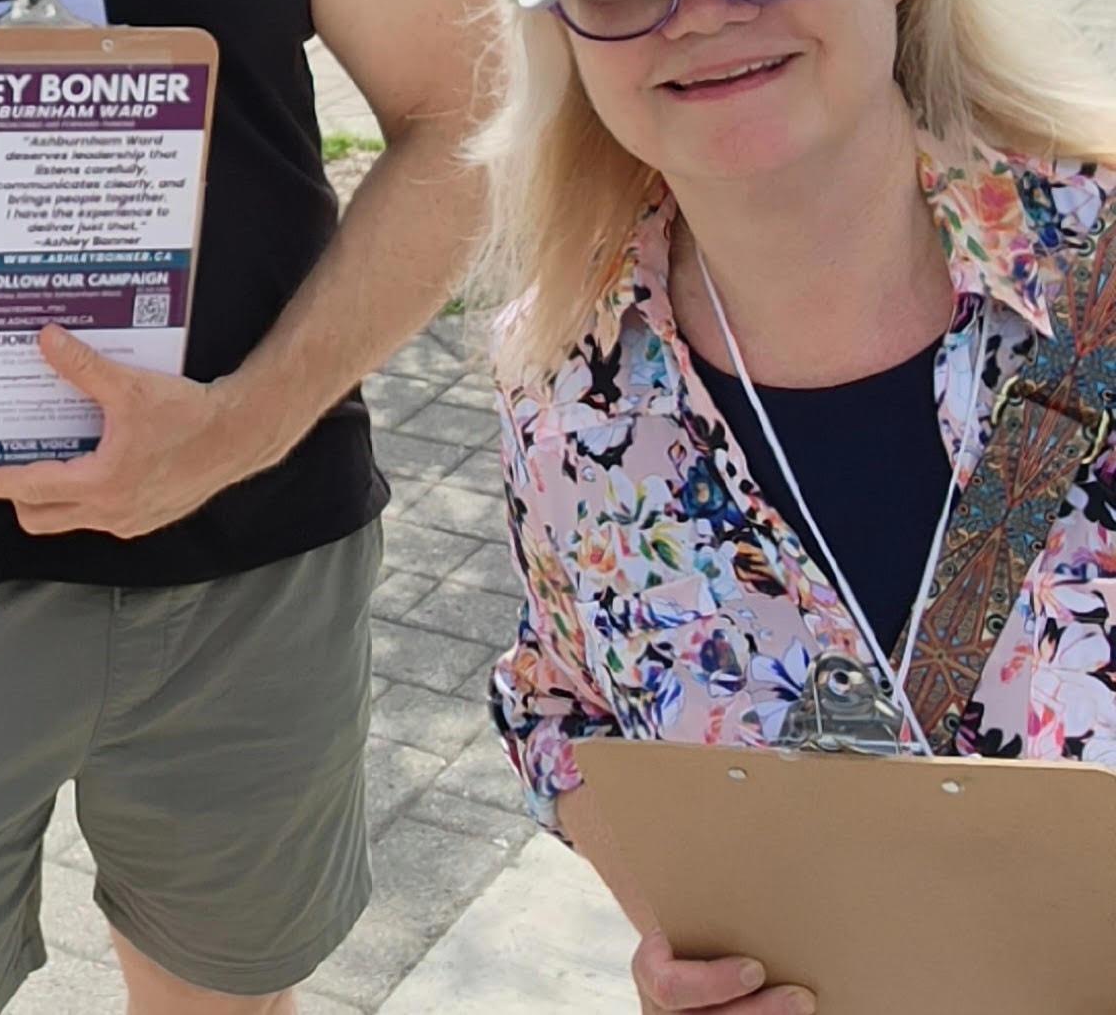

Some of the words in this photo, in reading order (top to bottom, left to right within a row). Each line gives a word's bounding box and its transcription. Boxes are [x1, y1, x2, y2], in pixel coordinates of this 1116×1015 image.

[40, 73, 190, 103] BONNER
[100, 104, 158, 118] WARD
[126, 135, 163, 146] Ward
[5, 151, 68, 161] deserves
[71, 149, 146, 162] leadership
[149, 149, 178, 160] that
[34, 165, 80, 176] listens
[159, 179, 186, 189] and
[8, 194, 52, 207] brings
[54, 194, 102, 206] people
[14, 208, 49, 219] have
[51, 207, 74, 218] the
[77, 209, 153, 220] experience
[157, 206, 171, 217] to
[27, 223, 76, 233] deliver
[77, 221, 104, 235] just
[92, 235, 142, 246] Bonner
[3, 251, 172, 264] WWW.ASHLEYBONNER.CA
[51, 273, 84, 286] OUR
[88, 271, 169, 286] CAMPAIGN
[2, 440, 38, 451] YOUR
[40, 439, 79, 450] VOICE
